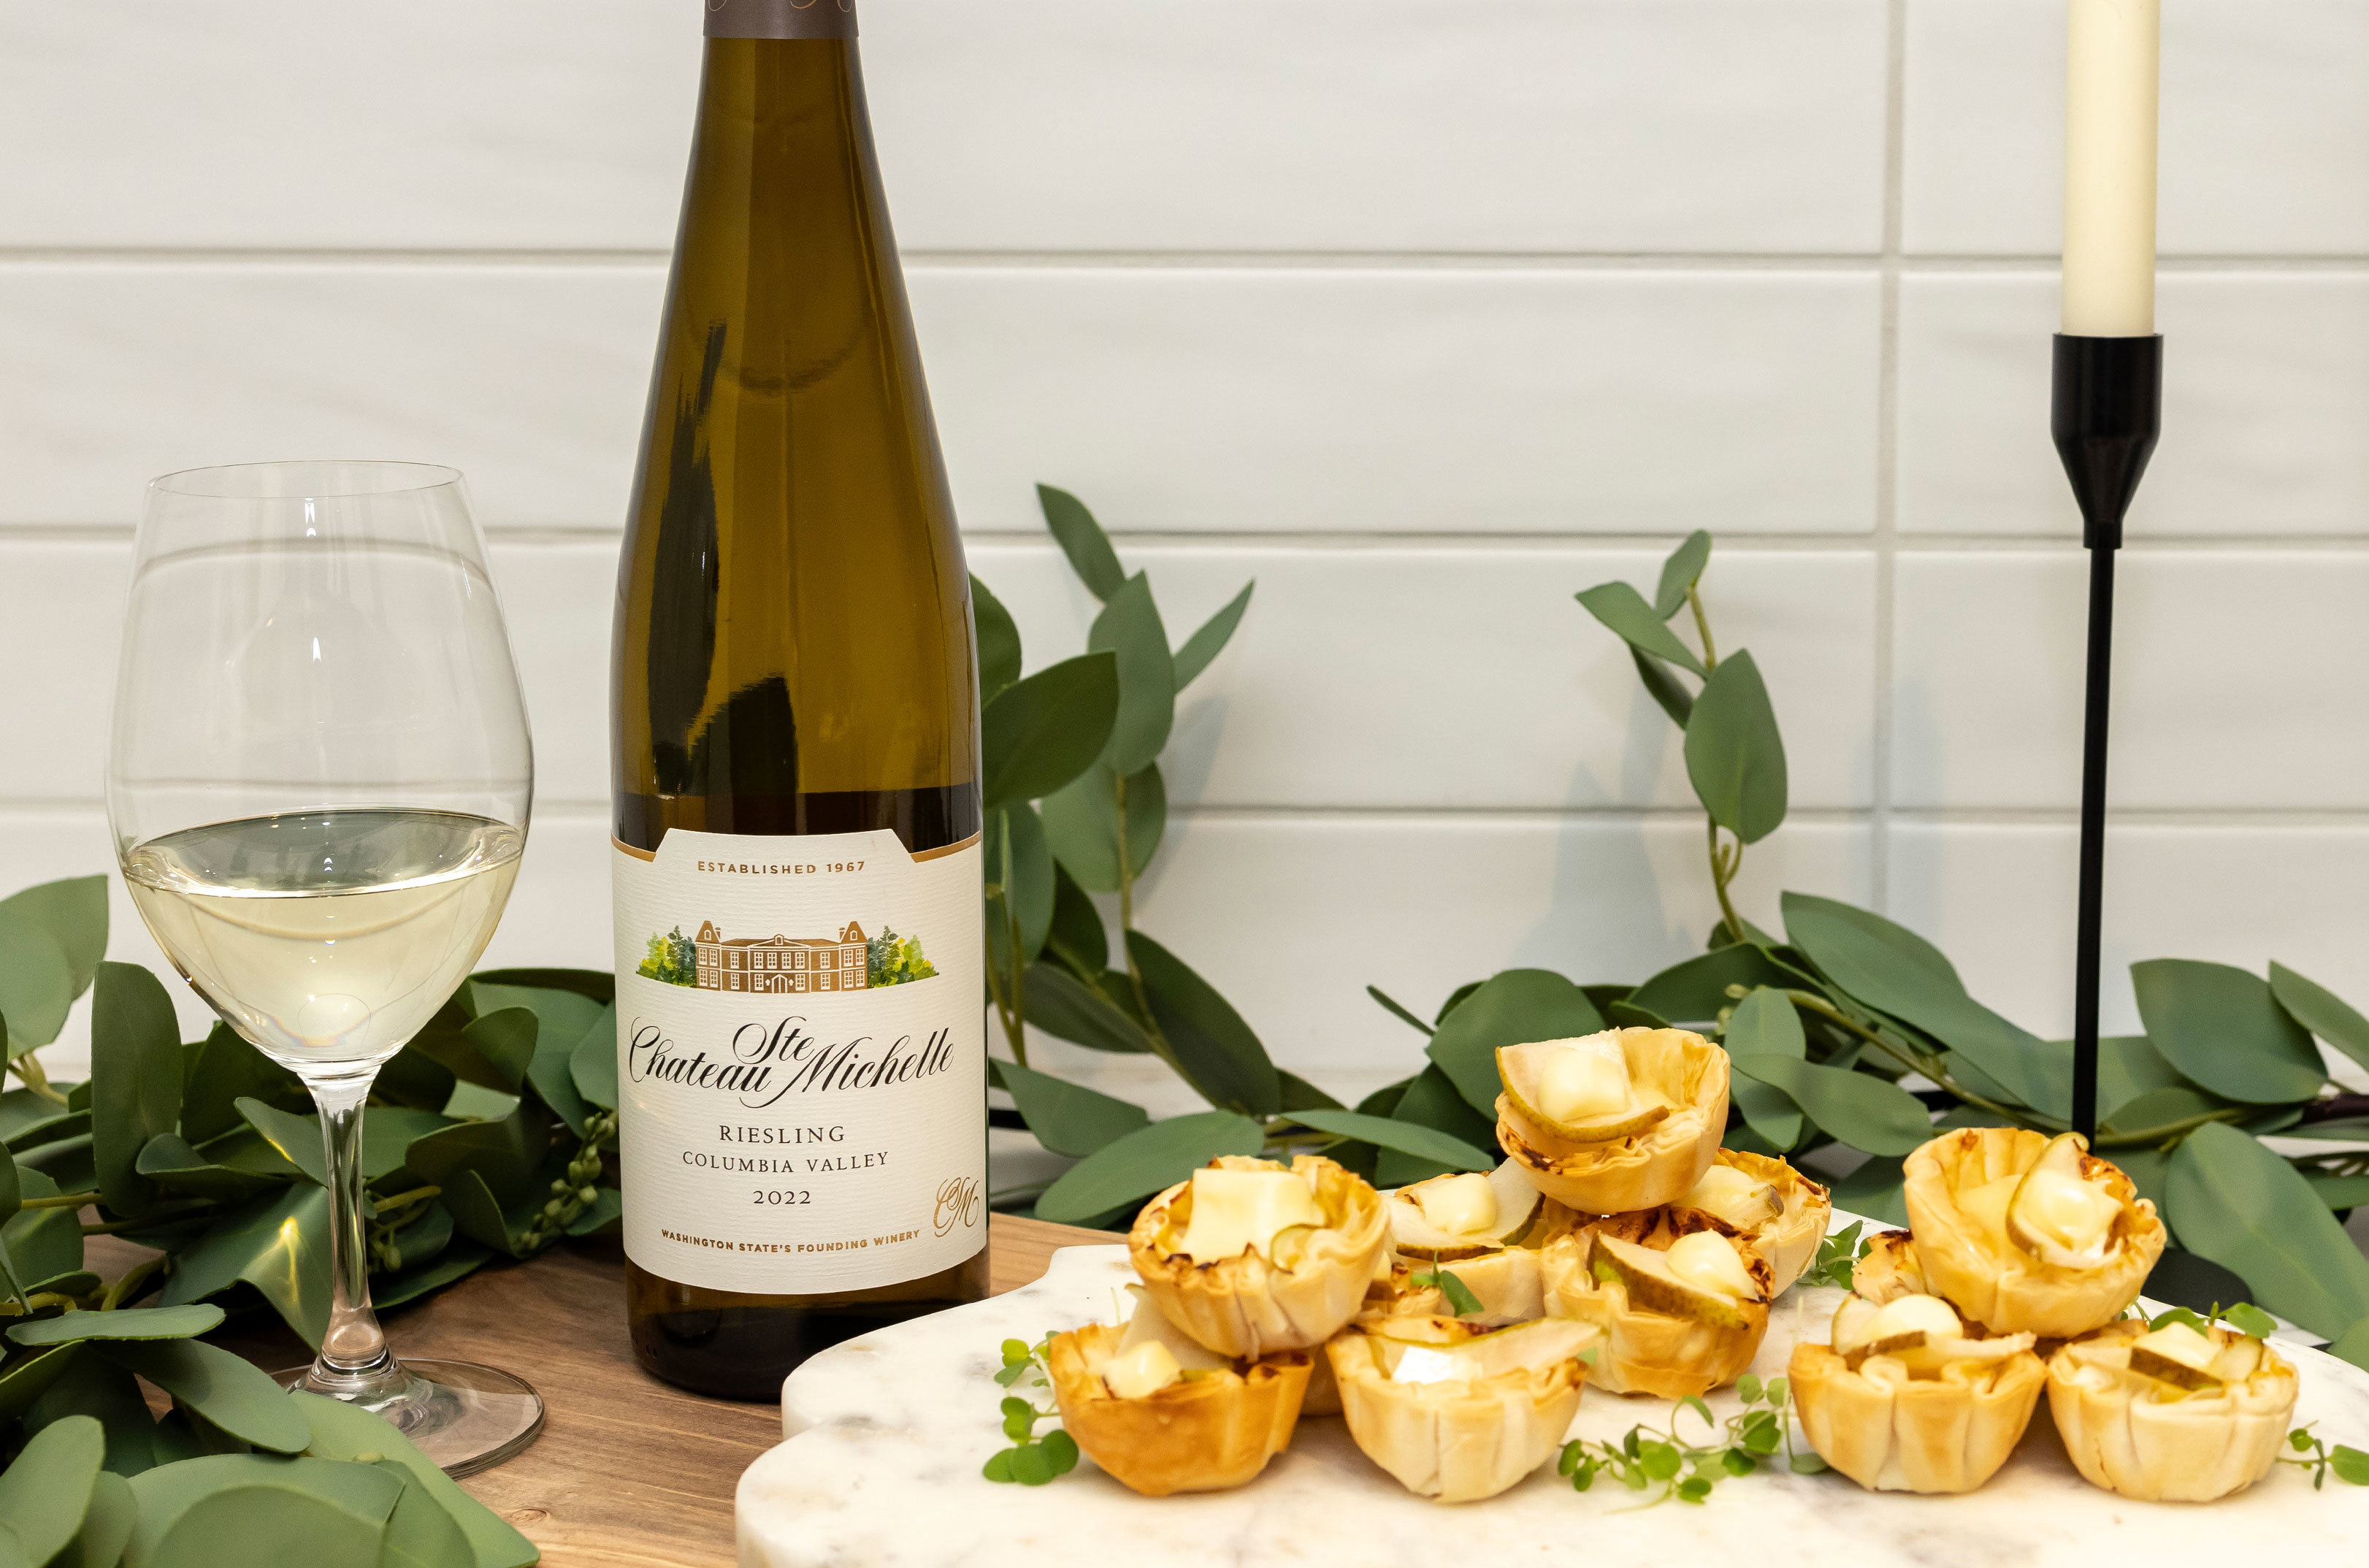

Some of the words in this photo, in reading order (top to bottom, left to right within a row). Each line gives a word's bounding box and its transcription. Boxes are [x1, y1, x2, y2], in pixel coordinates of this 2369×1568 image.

[697, 860, 816, 873] ESTABLISHED
[826, 861, 865, 873] 1967
[732, 1016, 815, 1064] Ste
[629, 1017, 772, 1093] Chateau
[739, 1027, 955, 1109] Michelle
[719, 1125, 846, 1144] RIESLING
[682, 1151, 794, 1173] COLUMBIA
[806, 1151, 889, 1171] VALLEY
[753, 1190, 811, 1205] 2022
[661, 1228, 734, 1250] WASHINGTON
[797, 1240, 868, 1253] FOUNDING
[873, 1228, 920, 1246] WINERY
